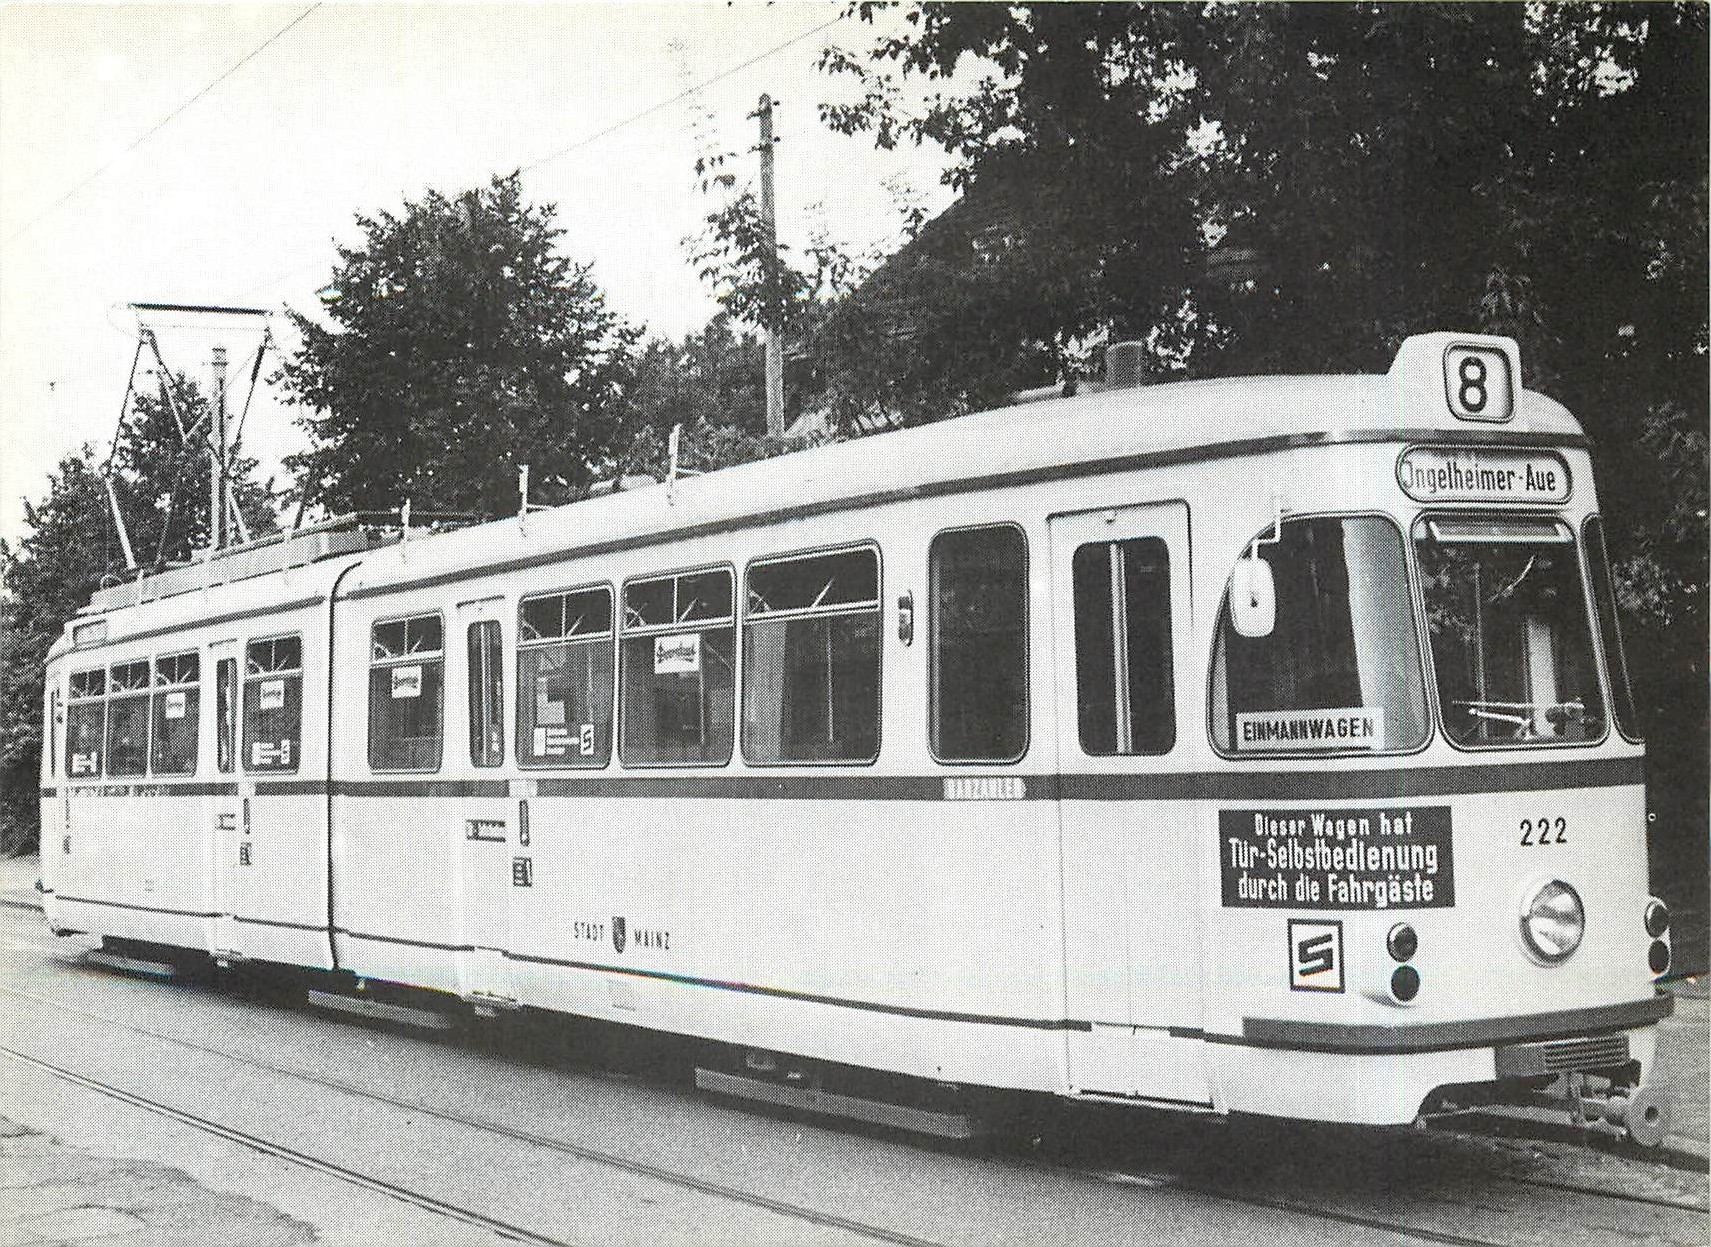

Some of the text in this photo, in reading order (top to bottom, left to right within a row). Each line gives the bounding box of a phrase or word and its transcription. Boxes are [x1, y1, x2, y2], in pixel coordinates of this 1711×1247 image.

[1459, 356, 1487, 413] 8
[1243, 717, 1374, 742] EINMANNWAGEN
[1254, 812, 1413, 839] Dieser Wagen hat
[1520, 817, 1567, 846] 222
[1229, 837, 1438, 873] Tür-Selbstbedienung
[1238, 870, 1434, 908] durch die Fahrgäste
[574, 922, 671, 950] STADT MAINZ
